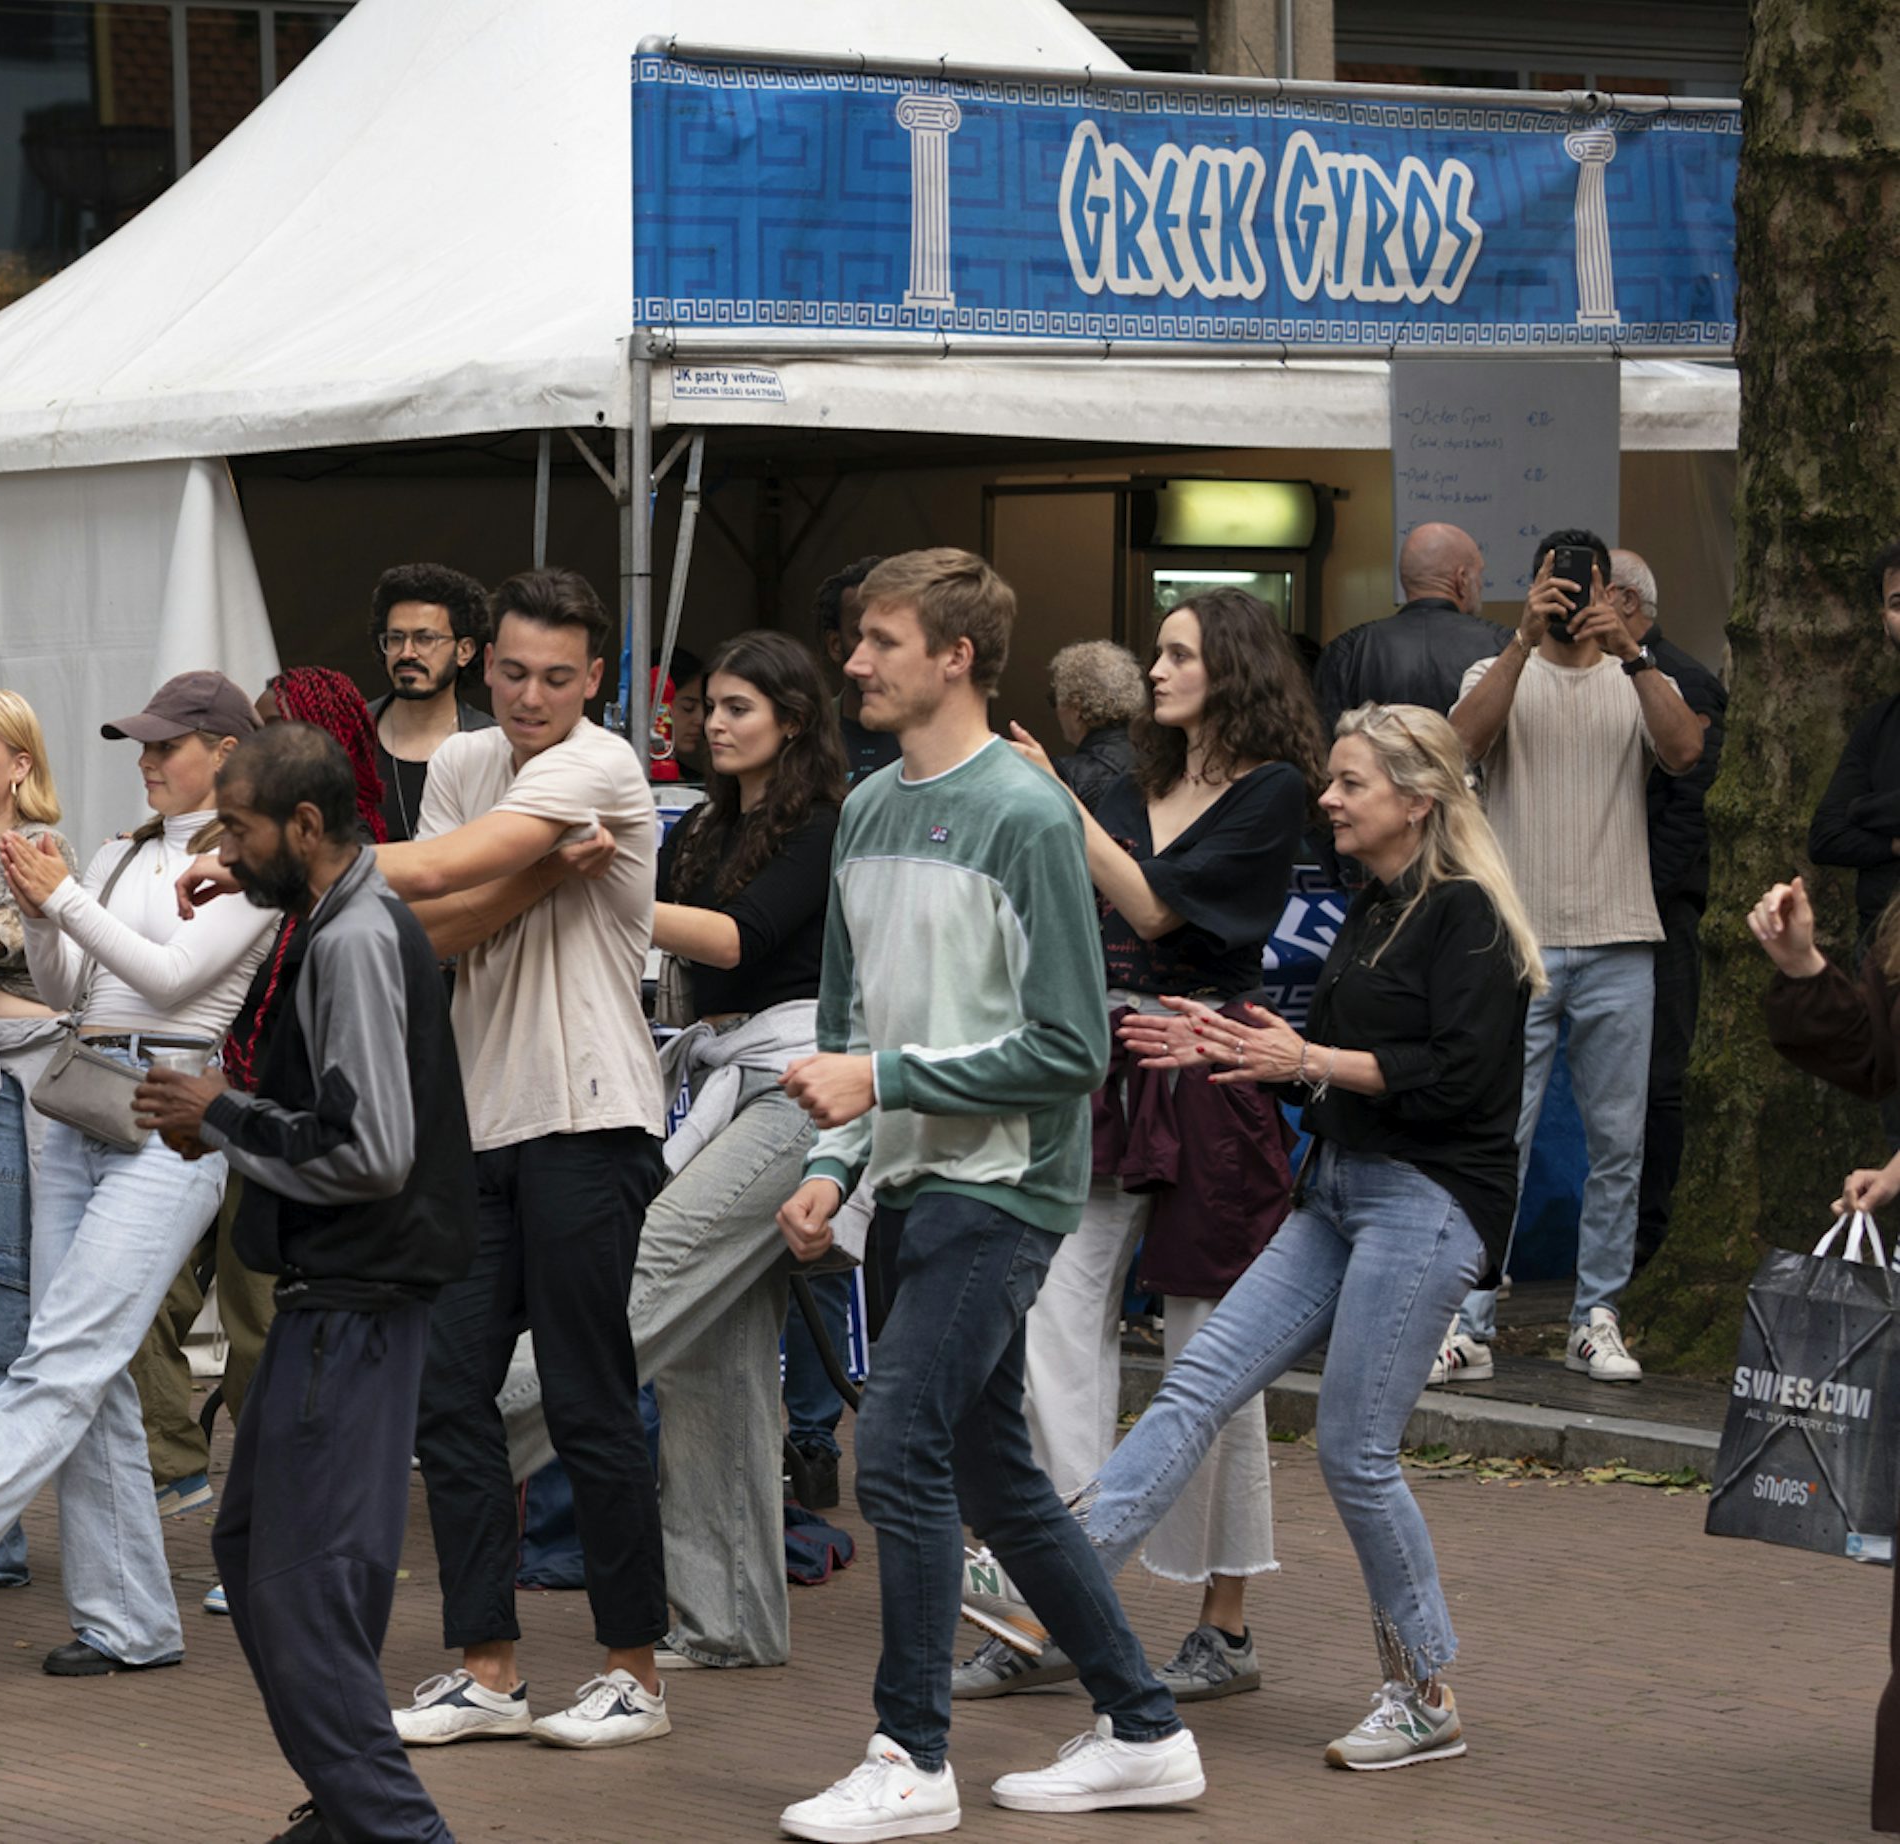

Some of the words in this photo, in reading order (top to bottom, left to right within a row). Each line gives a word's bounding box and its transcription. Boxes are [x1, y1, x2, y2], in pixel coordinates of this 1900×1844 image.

[676, 368, 692, 381] JK
[695, 371, 728, 385] party
[731, 371, 777, 385] verhuur
[1753, 1472, 1808, 1507] snipes
